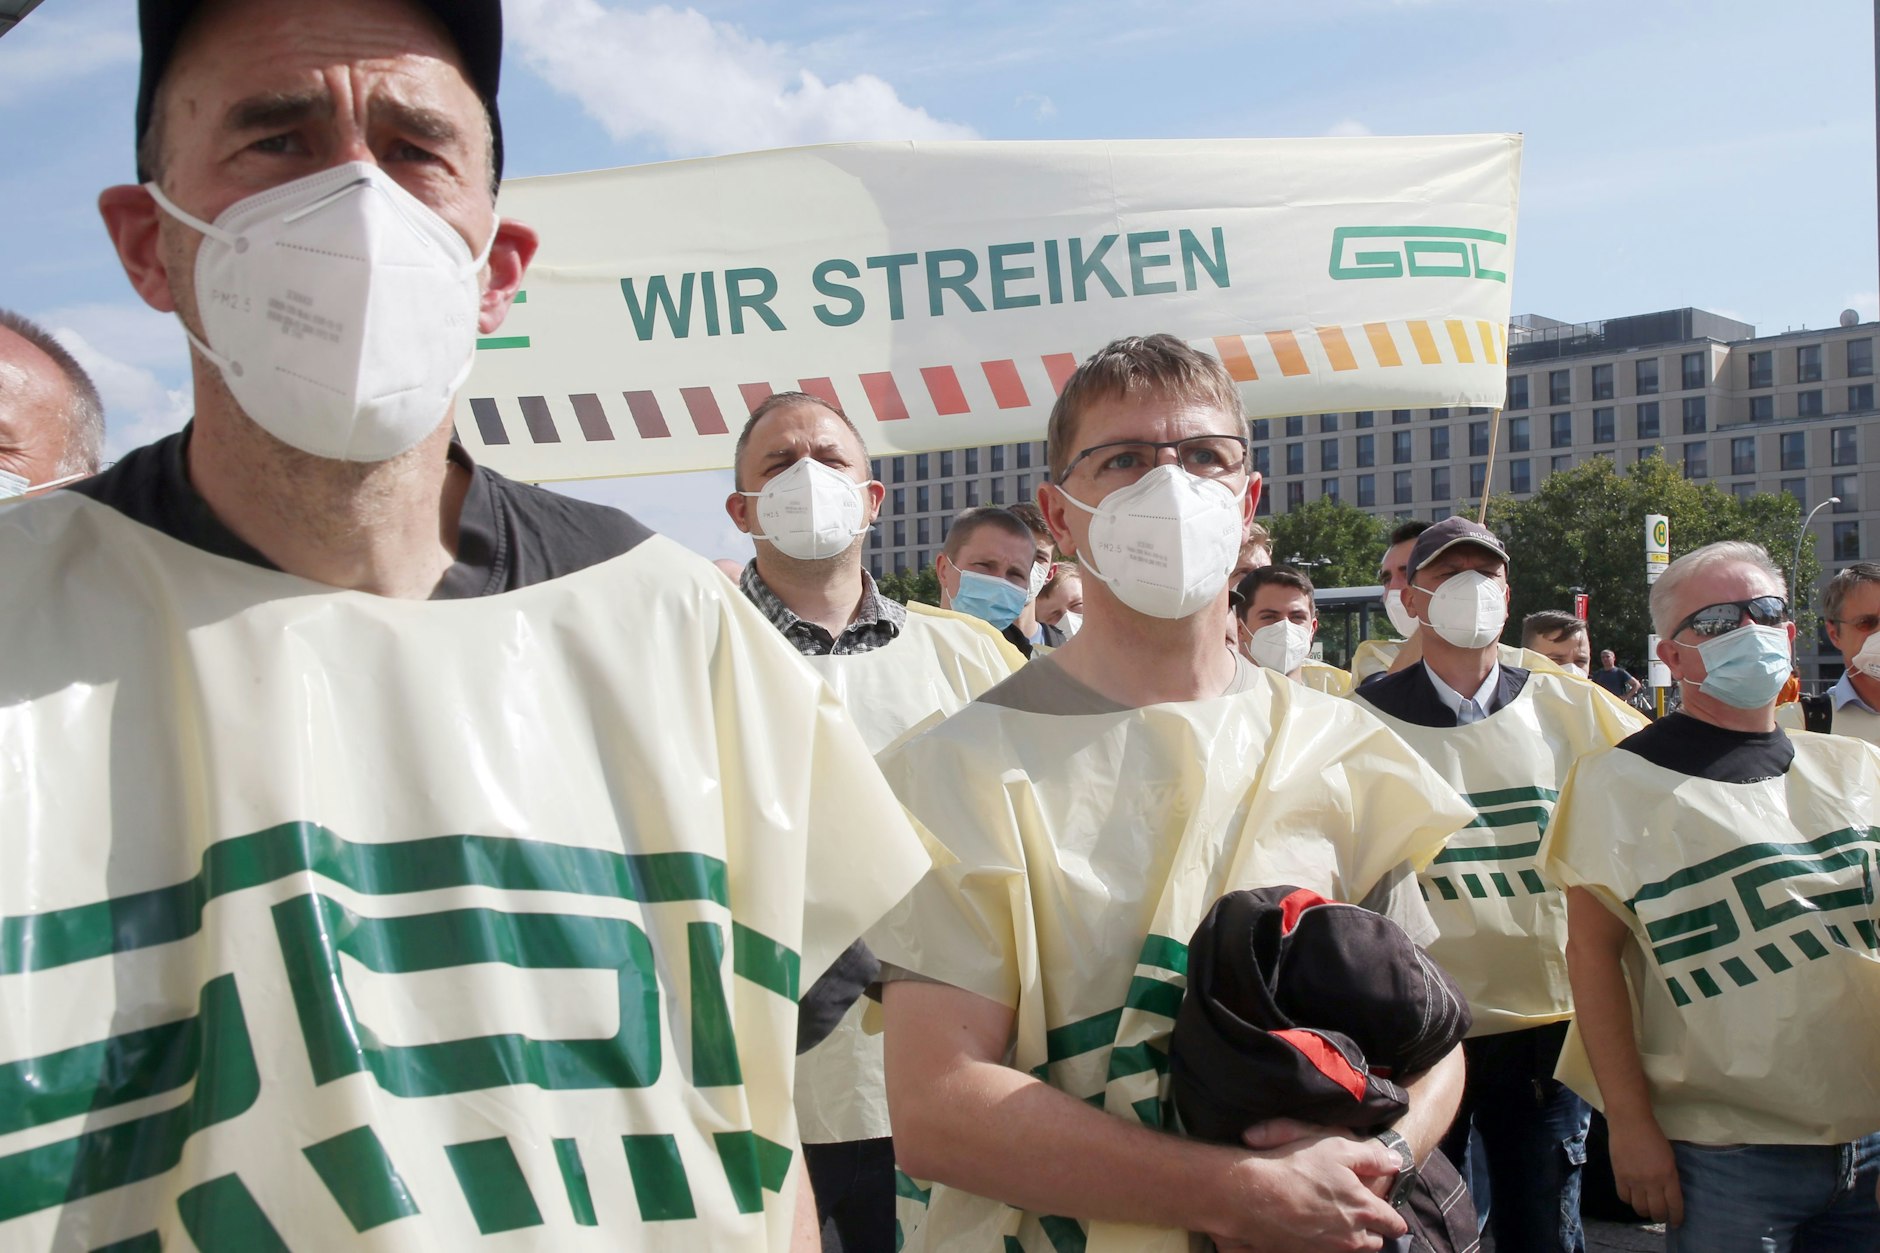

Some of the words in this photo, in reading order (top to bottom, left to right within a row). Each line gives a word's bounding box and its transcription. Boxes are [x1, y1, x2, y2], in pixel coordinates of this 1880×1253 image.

[621, 267, 787, 341] WIR
[812, 227, 1230, 327] STREIKEN
[1329, 226, 1507, 283] GDL
